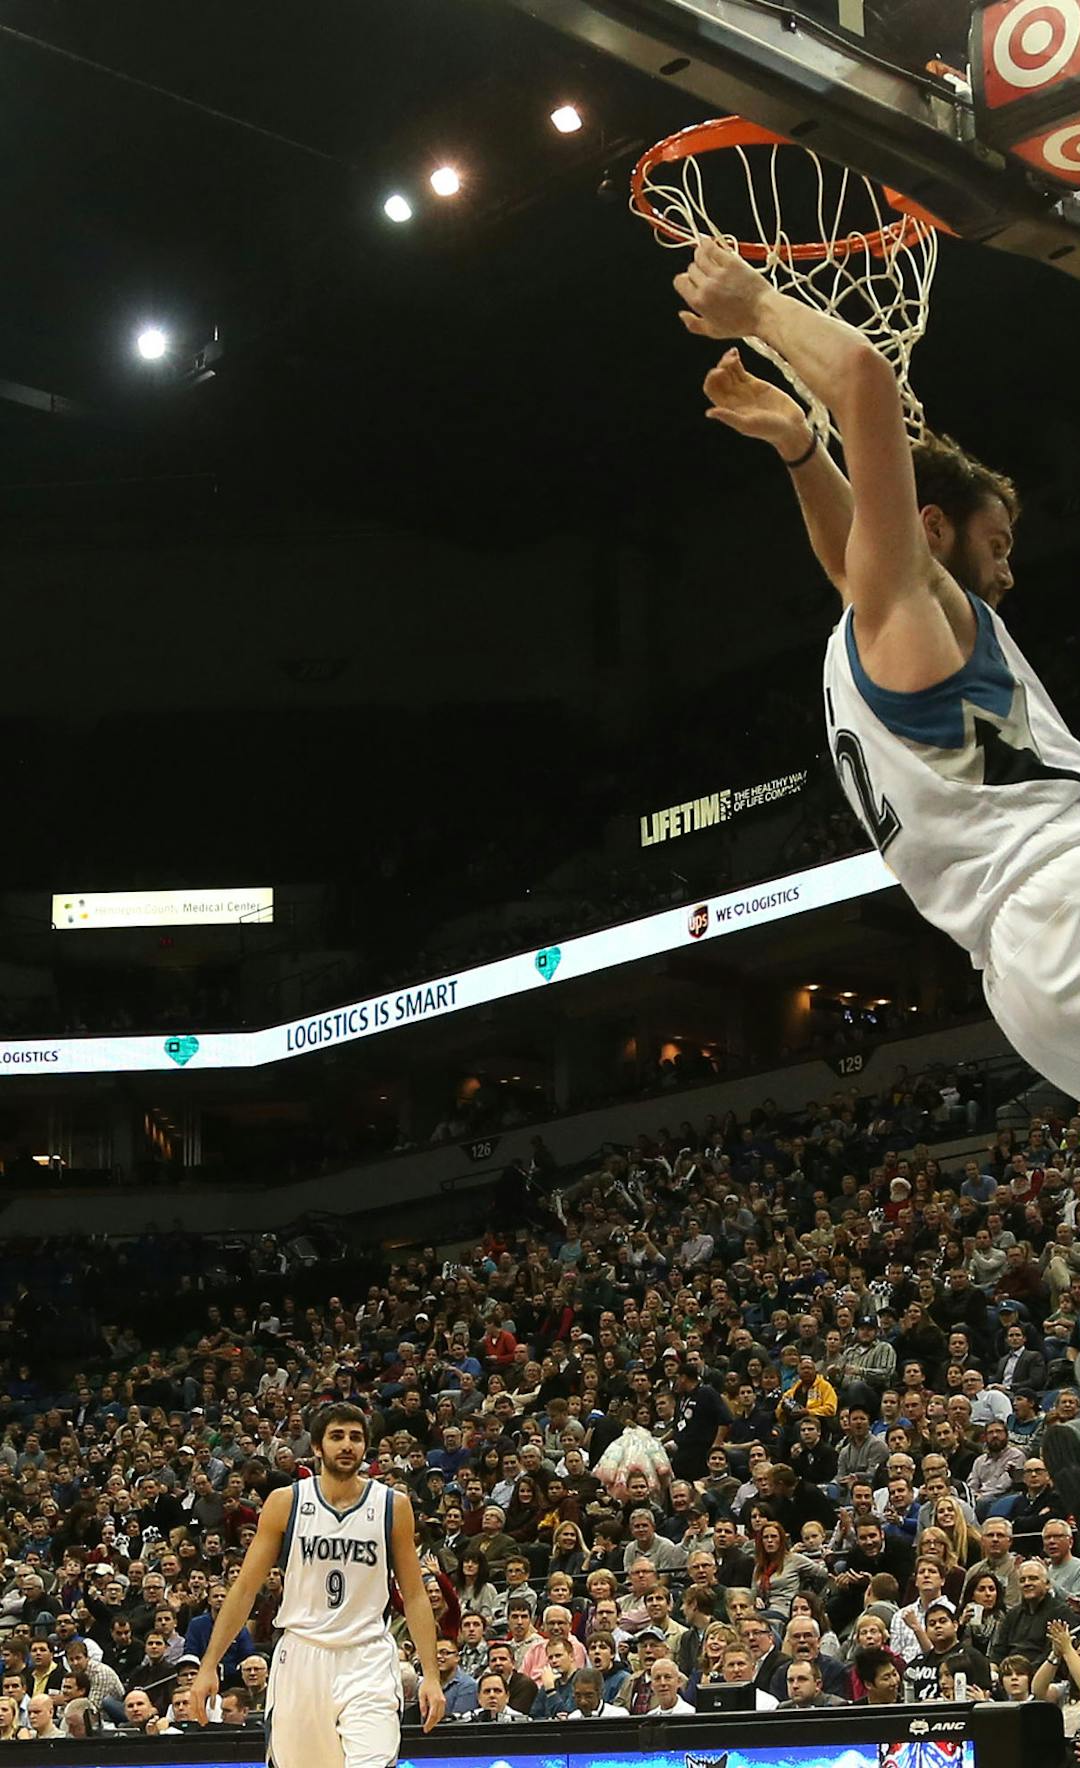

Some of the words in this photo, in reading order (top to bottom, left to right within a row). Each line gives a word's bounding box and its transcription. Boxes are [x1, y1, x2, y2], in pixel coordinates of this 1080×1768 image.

[734, 788, 750, 802] THE
[751, 776, 788, 797] HEALTHY
[734, 799, 746, 812] OF
[747, 794, 764, 808] LIFE
[183, 902, 223, 913] Medical
[227, 901, 260, 912] Center
[689, 913, 707, 934] ups
[716, 906, 732, 922] WE
[746, 887, 800, 914] LOGISTICS
[287, 1007, 368, 1051] LOGISTICS
[374, 1001, 389, 1026] IS
[395, 981, 458, 1020] SMART
[0, 1050, 58, 1063] OGISTICS
[838, 1054, 863, 1074] 129
[472, 1142, 491, 1159] 126
[298, 1535, 378, 1567] WOLVES
[326, 1569, 346, 1609] 9
[931, 1722, 966, 1731] ANC
